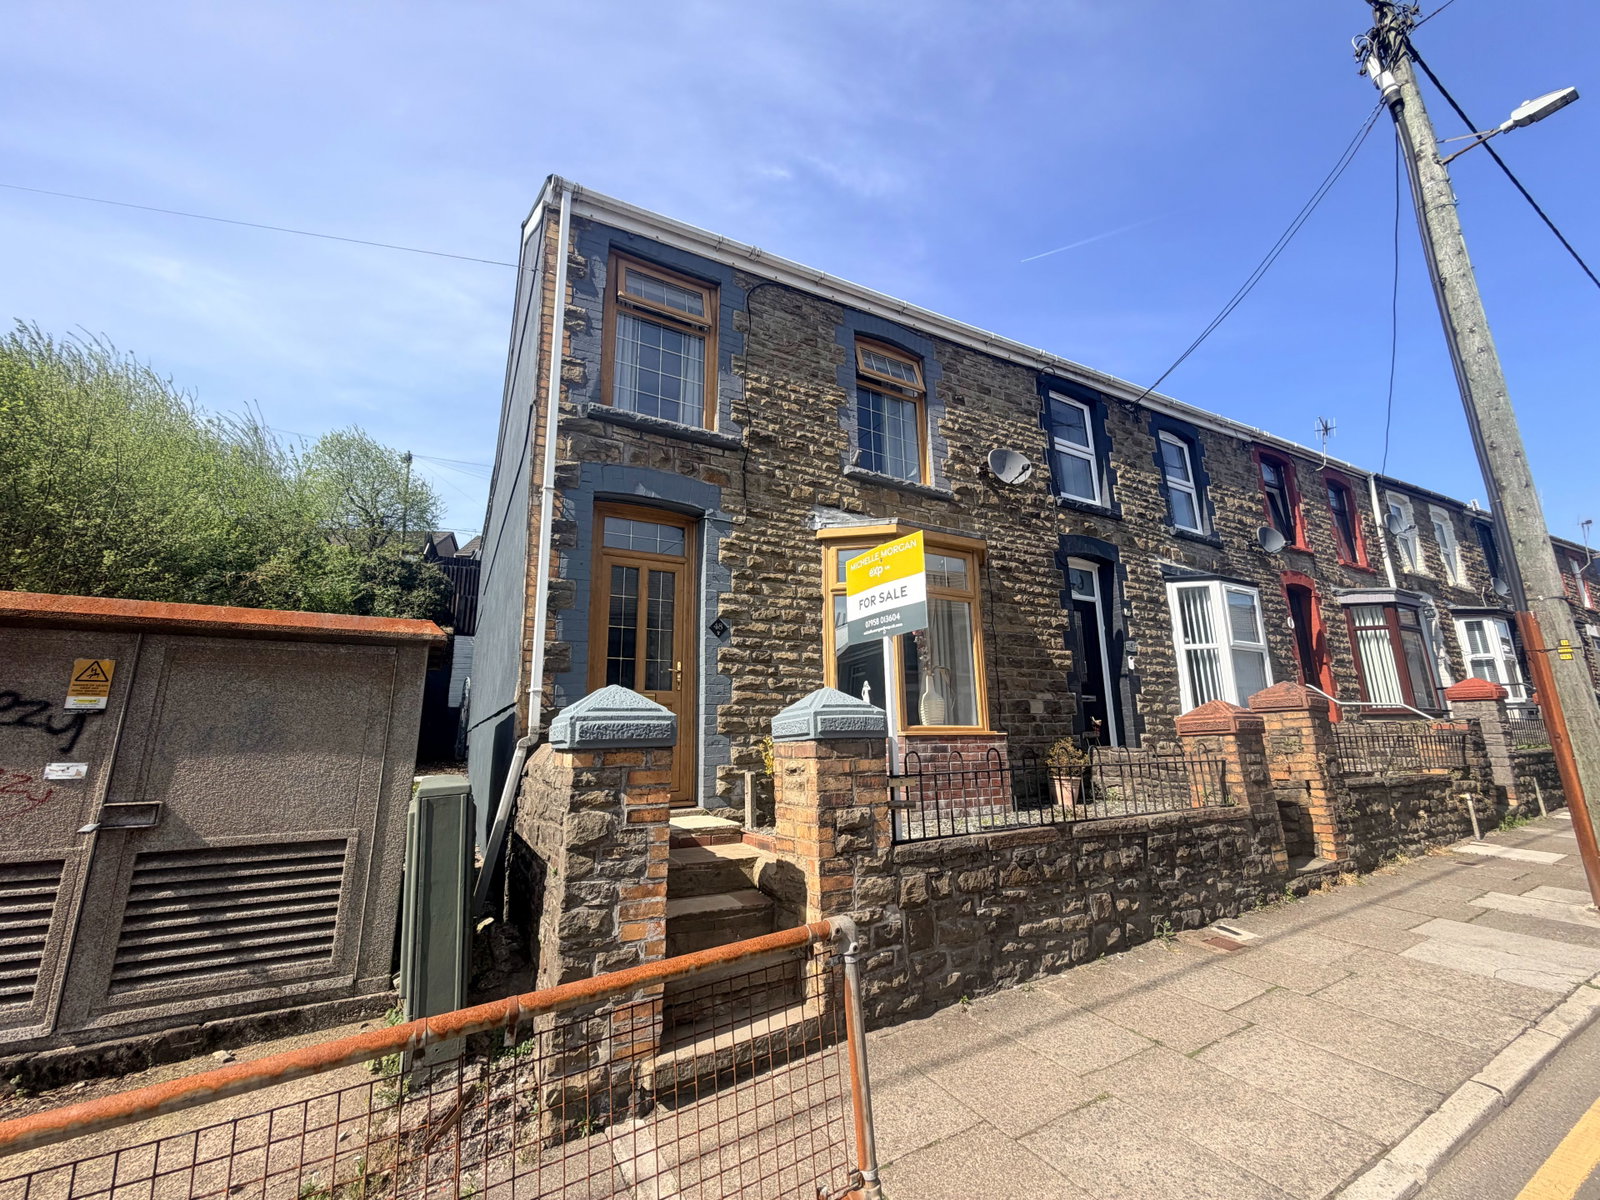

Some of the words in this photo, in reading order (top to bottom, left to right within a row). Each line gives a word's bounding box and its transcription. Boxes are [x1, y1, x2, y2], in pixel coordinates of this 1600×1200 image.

[850, 552, 880, 570] MICHELLE
[880, 539, 917, 558] MORGAN
[859, 595, 876, 610] FOR
[879, 585, 908, 603] SALE
[880, 612, 901, 624] 013604
